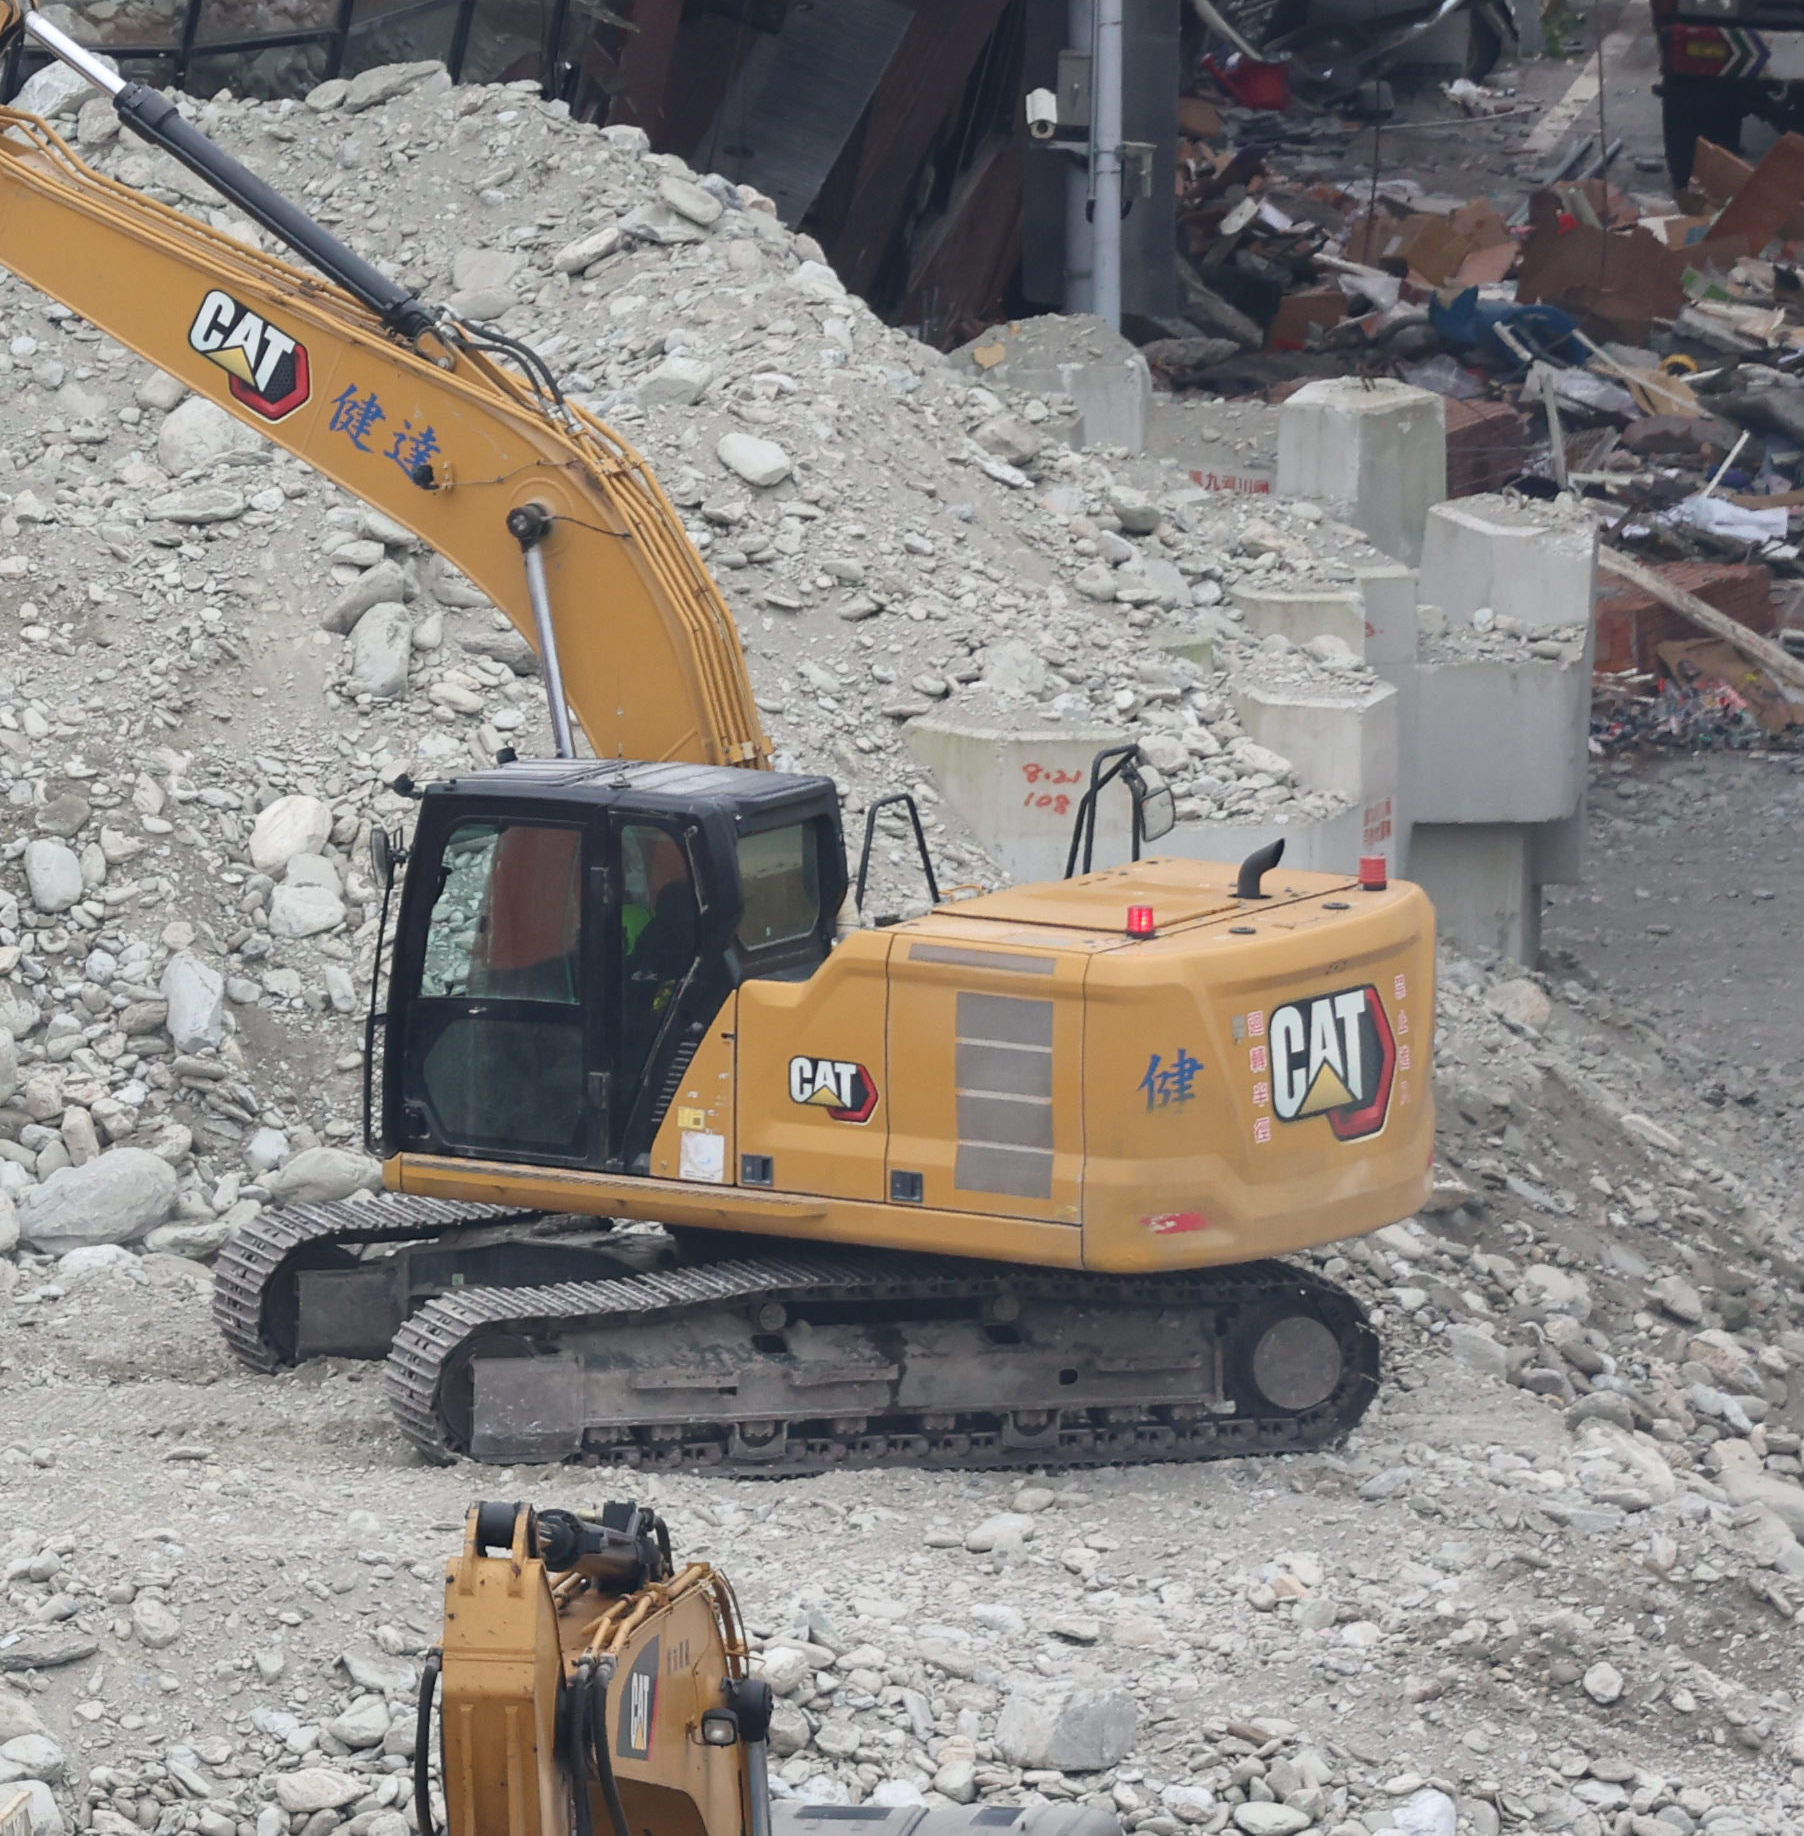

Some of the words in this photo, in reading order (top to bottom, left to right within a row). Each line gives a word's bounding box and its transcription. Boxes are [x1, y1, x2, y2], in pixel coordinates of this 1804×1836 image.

[191, 289, 297, 392] CAT
[1023, 791, 1071, 815] 108
[790, 1055, 857, 1108] CAT
[1269, 989, 1366, 1119] CAT
[630, 1671, 650, 1751] CAT
